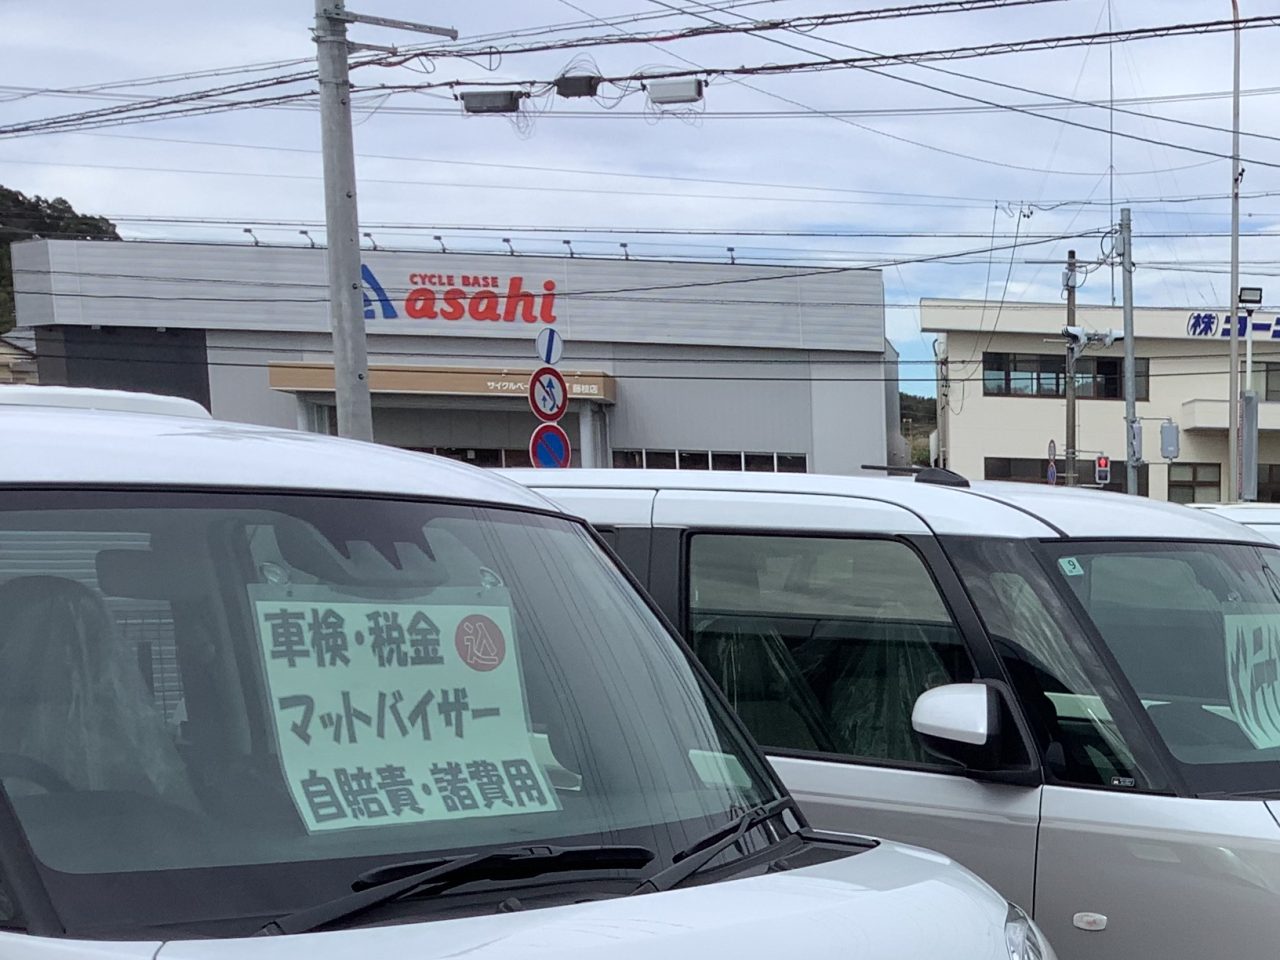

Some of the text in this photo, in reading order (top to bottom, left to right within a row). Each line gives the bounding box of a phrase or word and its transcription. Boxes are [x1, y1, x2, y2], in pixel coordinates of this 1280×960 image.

[405, 276, 557, 323] asahi
[409, 273, 499, 287] CYCLE BASE
[264, 608, 499, 668] 車検・税金 込
[278, 687, 500, 746] マットバイザー
[300, 758, 549, 823] 自賠責・諸費用
